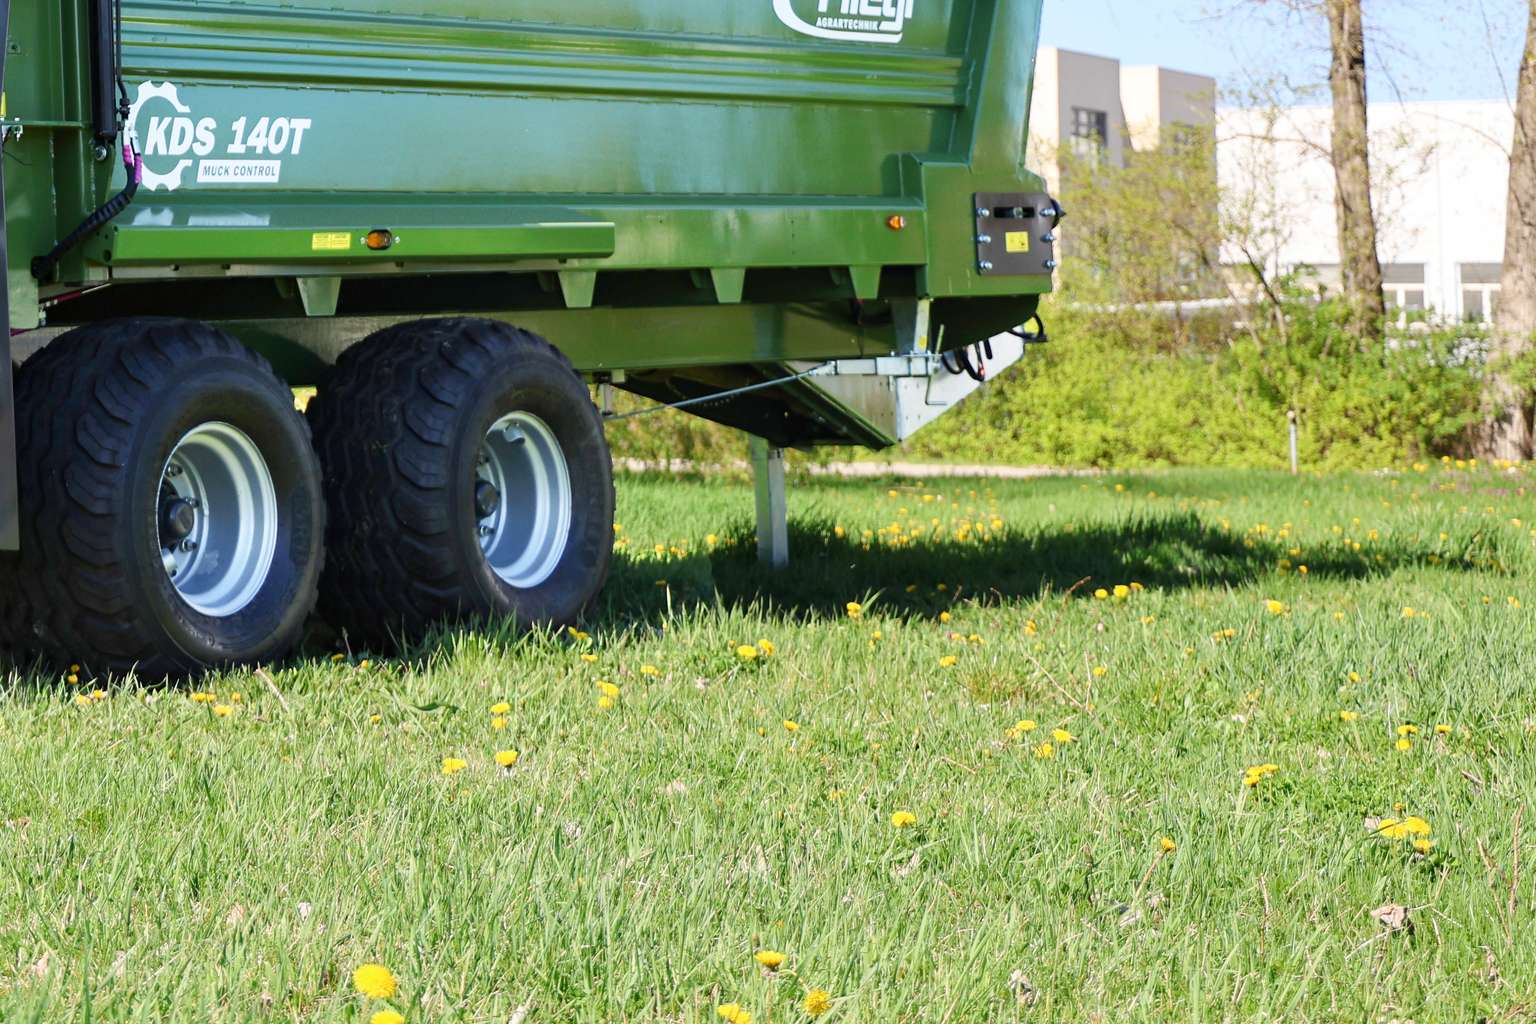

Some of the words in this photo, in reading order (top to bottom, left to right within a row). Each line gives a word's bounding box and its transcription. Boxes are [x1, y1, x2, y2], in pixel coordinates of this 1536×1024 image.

[815, 16, 880, 31] AGRARTECHNIK
[144, 116, 217, 156] KDS
[226, 116, 312, 156] 140T
[202, 165, 230, 176] MUCK
[233, 165, 277, 176] CONTROL
